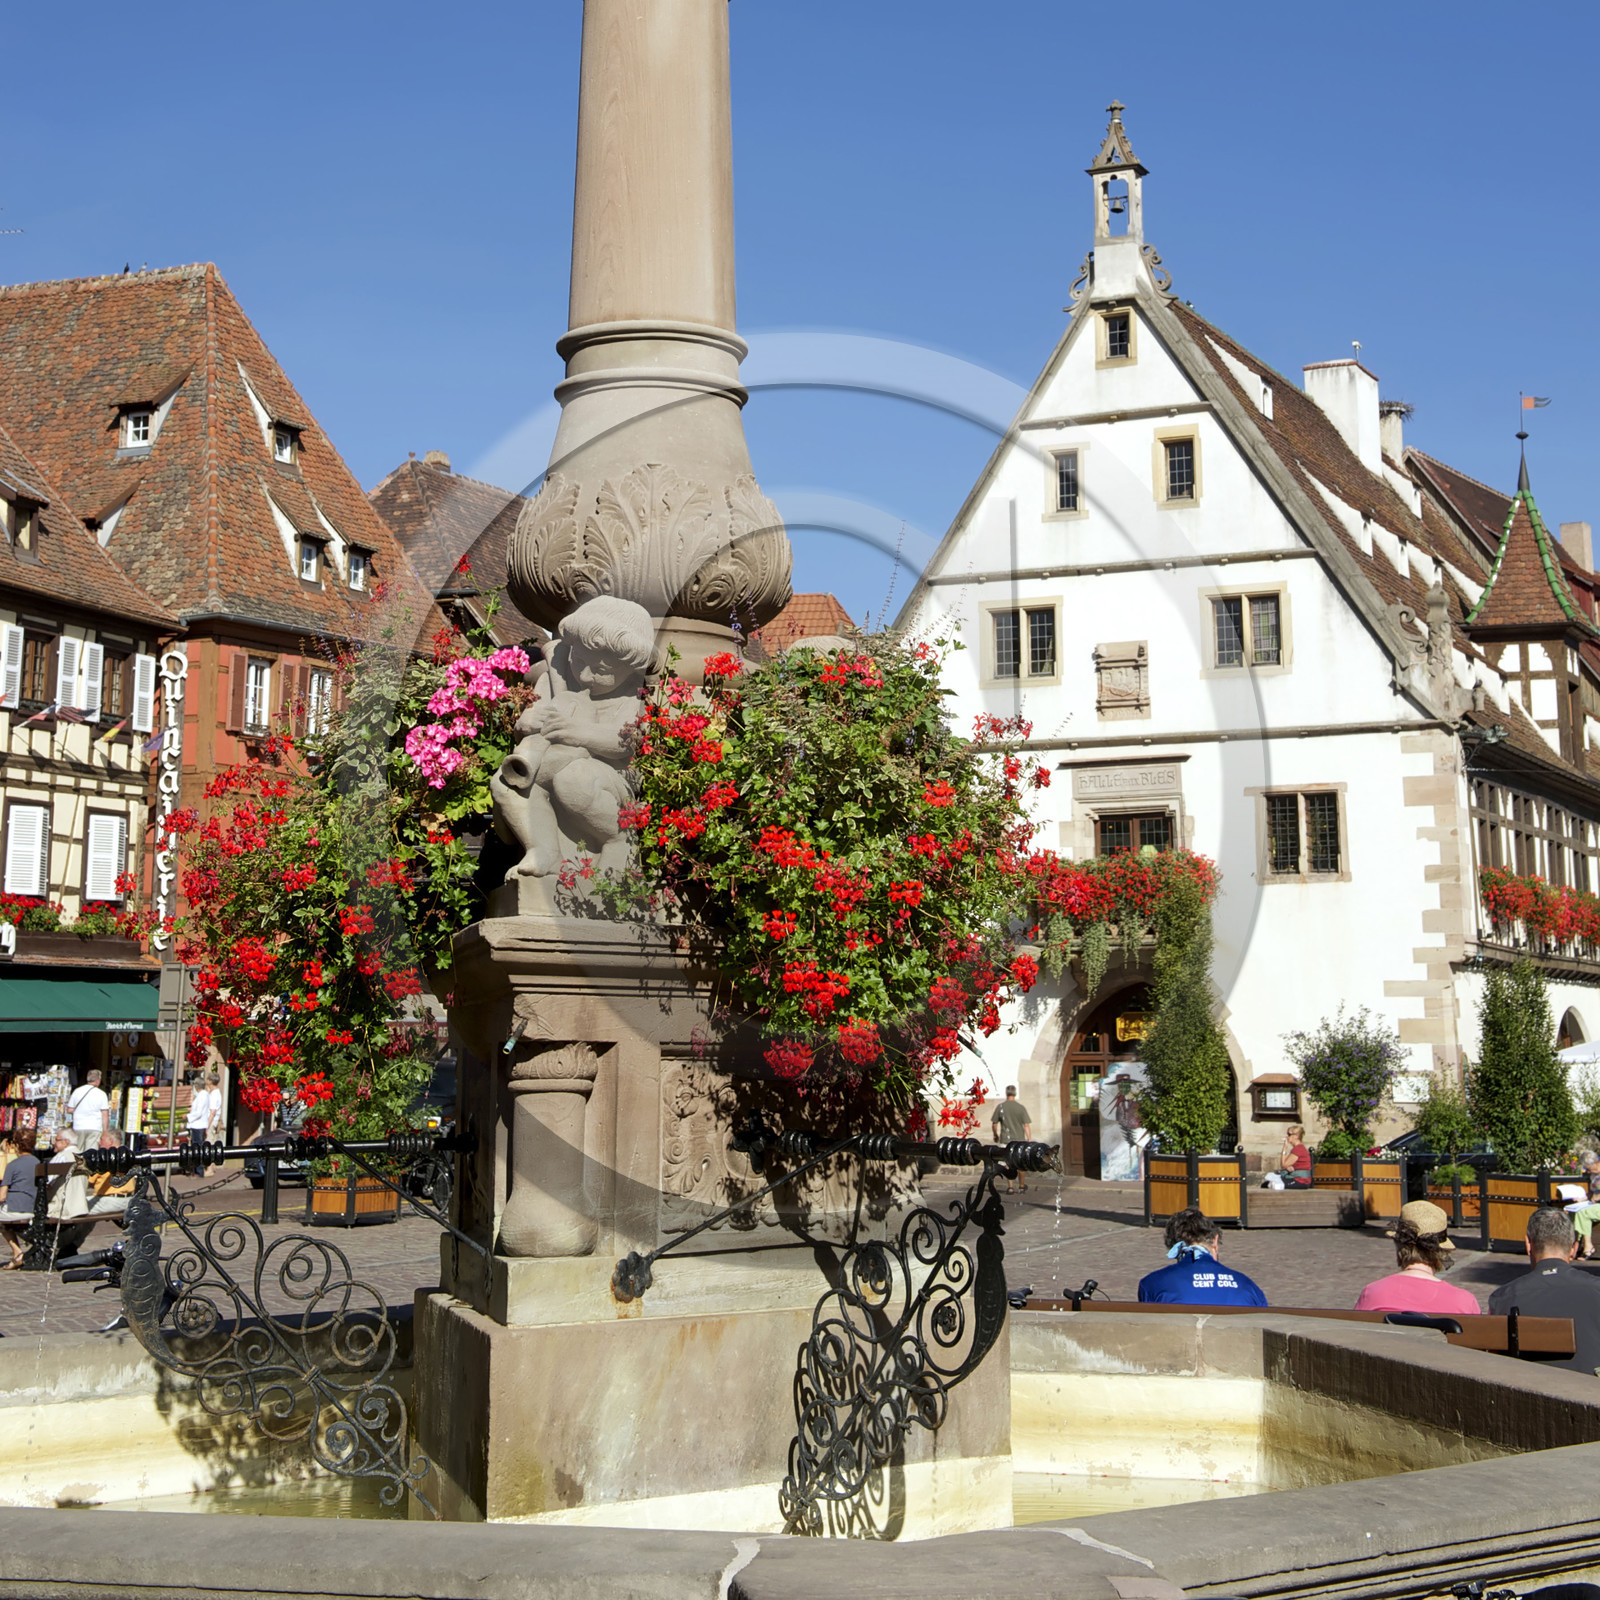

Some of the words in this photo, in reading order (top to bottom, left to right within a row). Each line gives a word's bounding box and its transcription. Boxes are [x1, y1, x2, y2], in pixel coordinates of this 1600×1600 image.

[1218, 1273, 1234, 1281] DES
[1193, 1280, 1214, 1288] CENT
[1217, 1280, 1238, 1288] COLS
